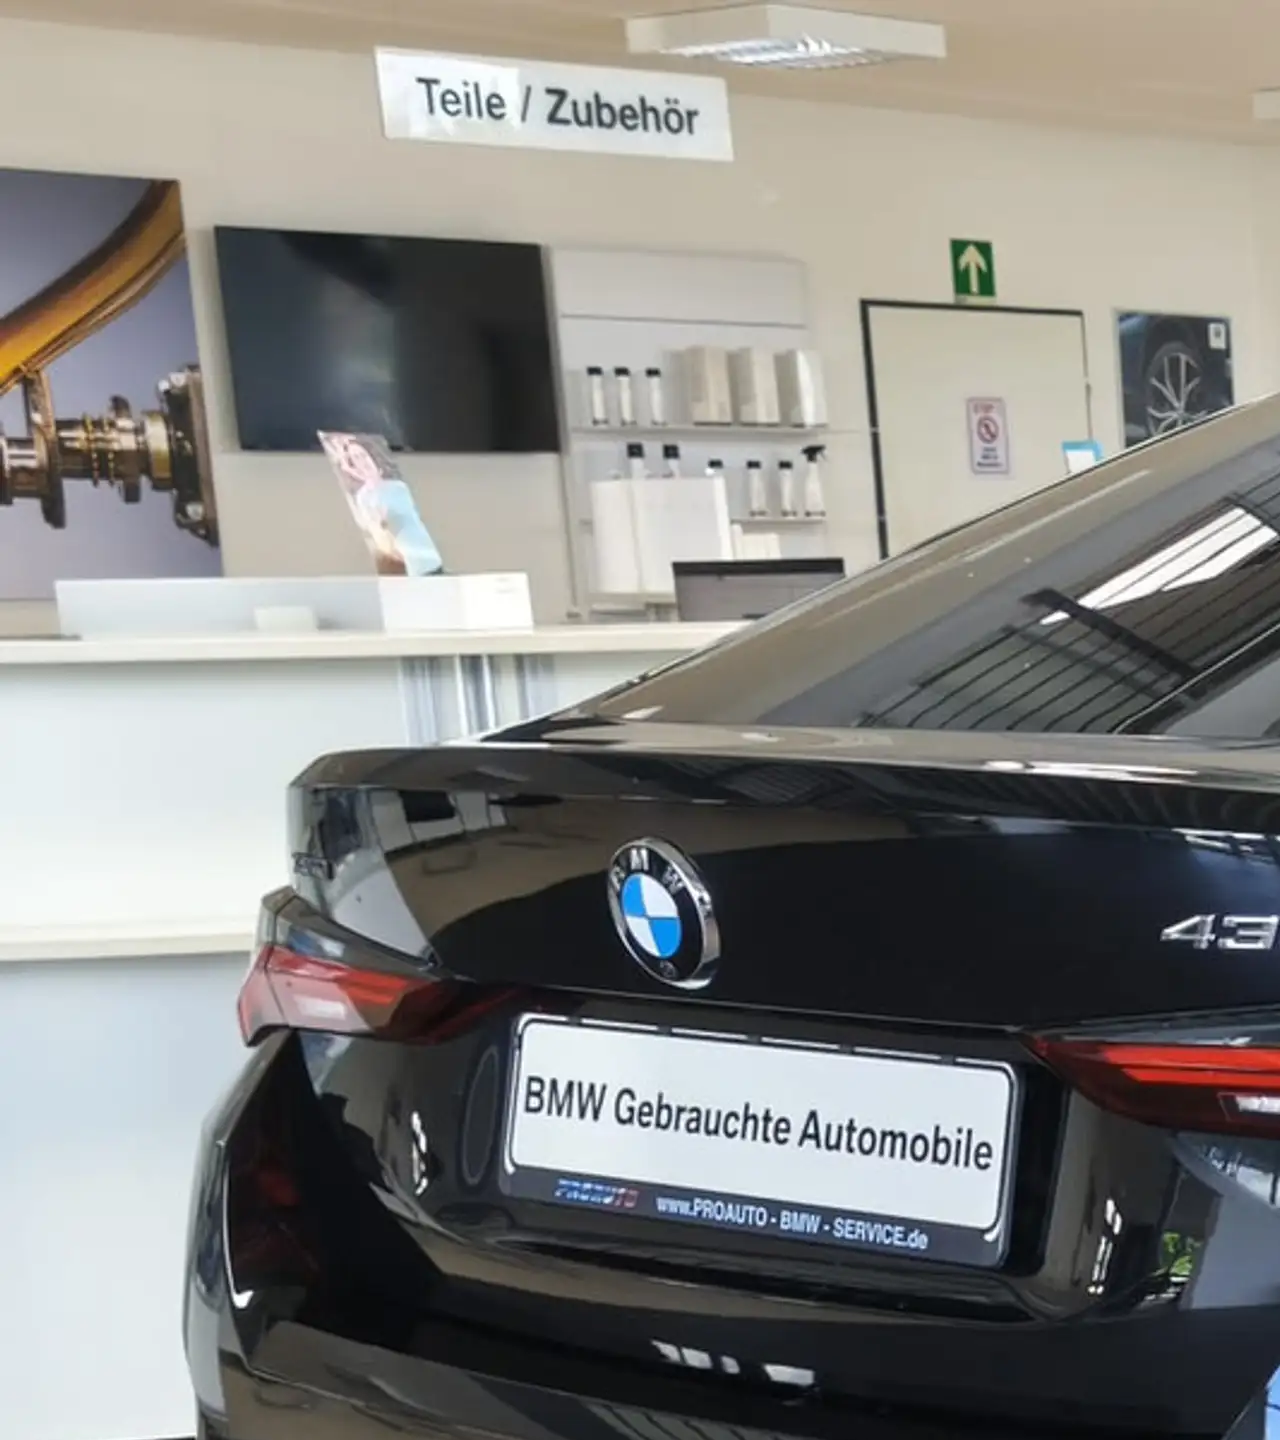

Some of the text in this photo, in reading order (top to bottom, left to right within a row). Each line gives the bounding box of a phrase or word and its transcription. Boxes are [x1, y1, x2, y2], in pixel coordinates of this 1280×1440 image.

[416, 77, 700, 135] Teile / Zubehör
[524, 1076, 993, 1170] BMW Gebrauchte Automobile
[832, 1215, 929, 1250] SERVICE.de
